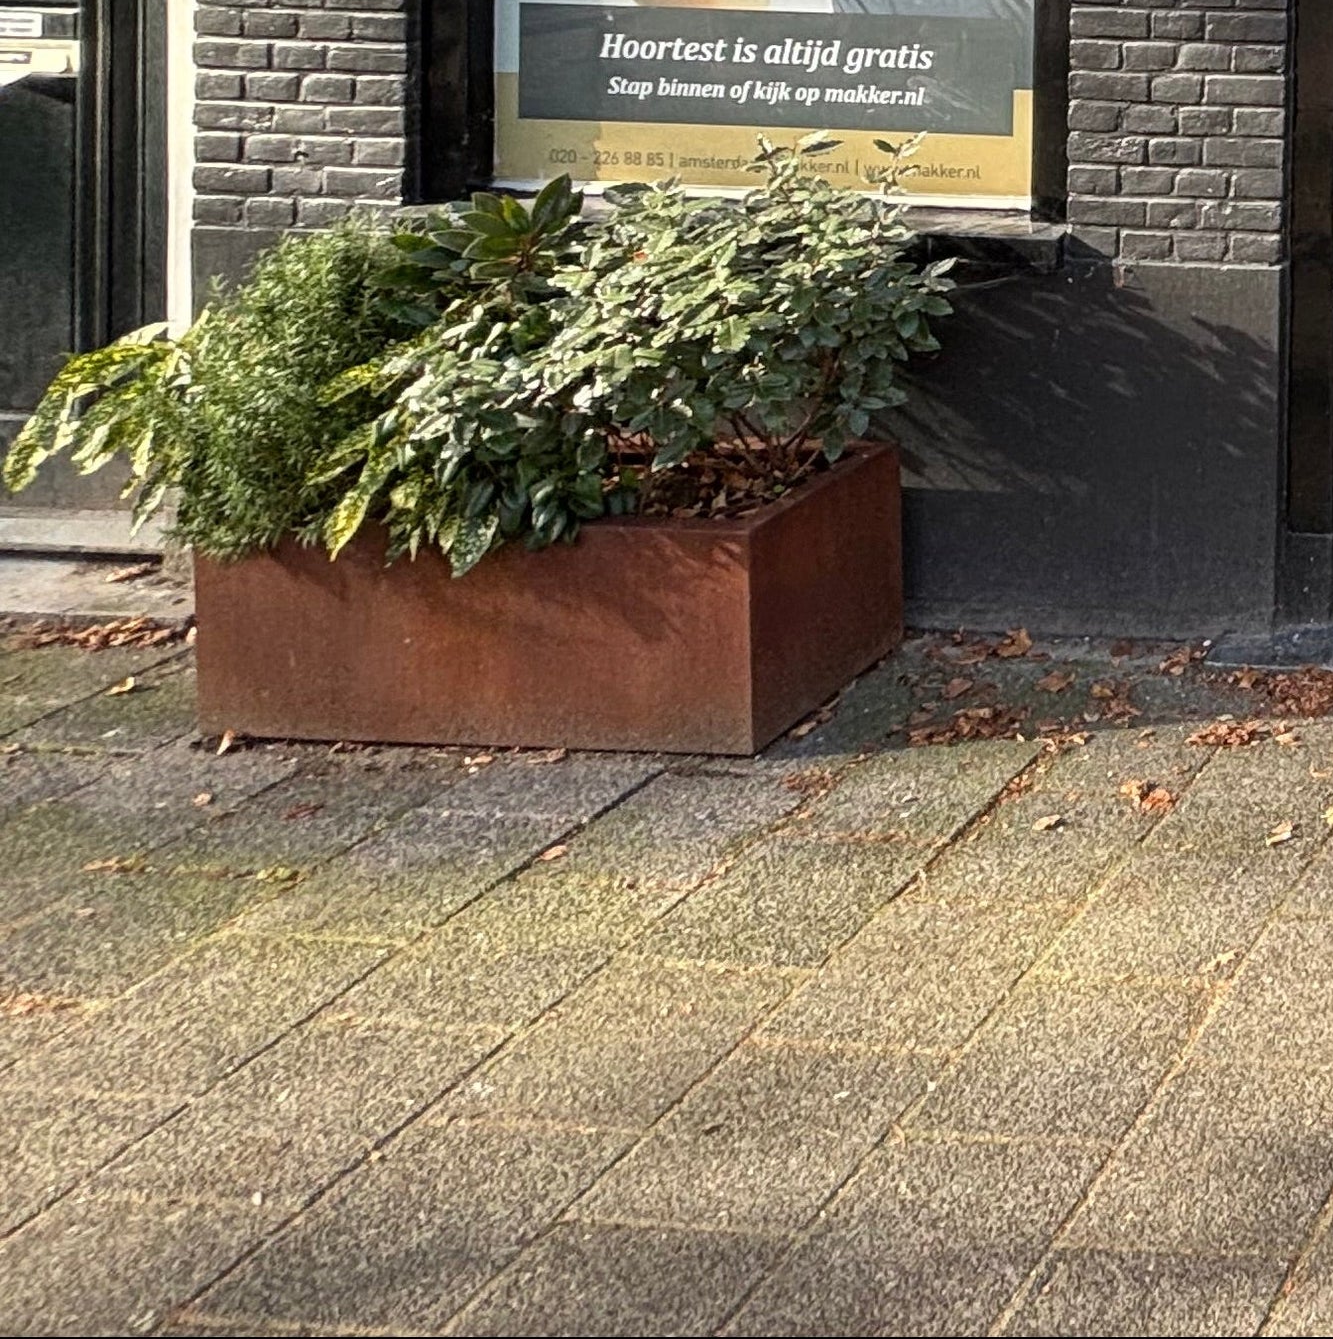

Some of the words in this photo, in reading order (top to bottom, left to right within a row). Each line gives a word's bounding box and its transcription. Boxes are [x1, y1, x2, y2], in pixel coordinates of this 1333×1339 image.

[600, 33, 727, 61] Hoortest
[733, 37, 758, 63] is
[764, 38, 841, 73] altijd
[843, 44, 934, 74] gratis
[607, 76, 653, 99] Stap
[656, 78, 725, 99] binnen
[730, 80, 753, 103] of
[753, 81, 791, 105] kijk
[795, 88, 821, 106] op
[825, 84, 925, 106] makker.nl
[549, 148, 577, 164] 020
[593, 150, 620, 165] 226
[624, 150, 642, 166] 88
[646, 151, 665, 167] 85
